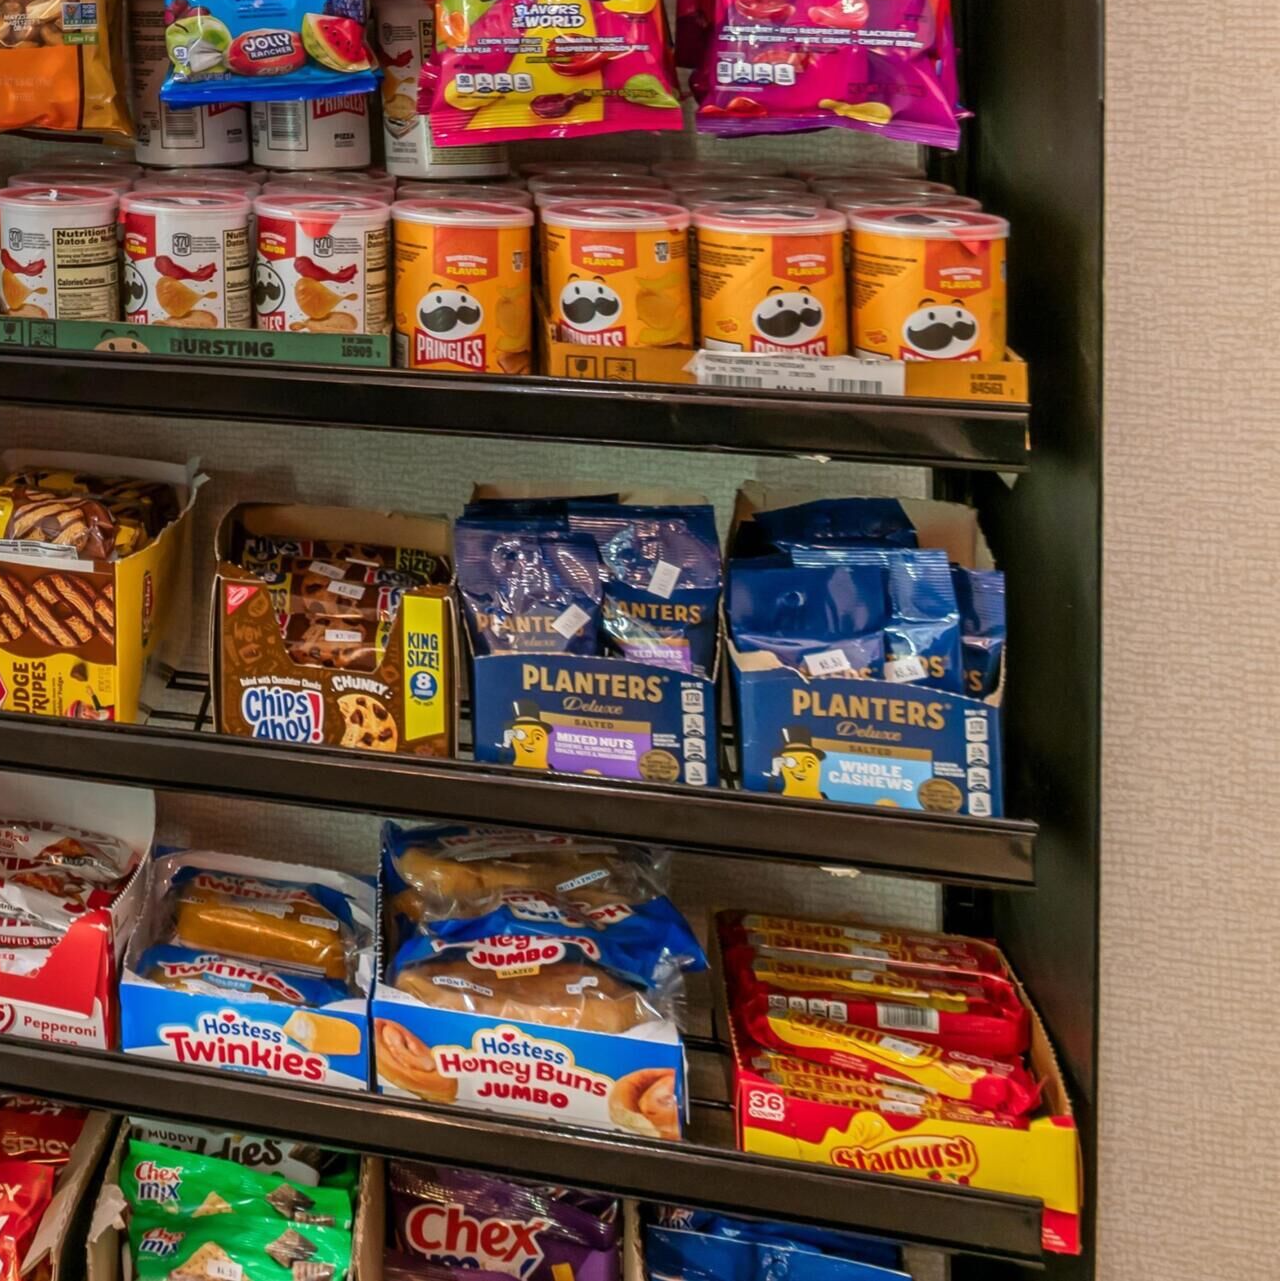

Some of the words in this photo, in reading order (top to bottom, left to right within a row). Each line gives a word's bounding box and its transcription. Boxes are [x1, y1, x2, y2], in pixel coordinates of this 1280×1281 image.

[515, 5, 578, 15] FLAVORS
[525, 13, 584, 28] WORLD
[242, 34, 290, 52] JOLLY
[250, 46, 294, 60] RANCHER
[57, 230, 105, 241] Nutrition
[170, 339, 274, 358] BURSTING
[416, 336, 482, 365] PRINGLES
[407, 632, 438, 650] KING
[407, 650, 439, 669] SIZE!
[523, 664, 662, 702] PLANTERS
[563, 696, 623, 716] Deluxe
[793, 689, 945, 728] PLANTERS
[574, 718, 613, 731] SALTED
[837, 721, 902, 742] Deluxe
[557, 732, 595, 746] MIXED
[598, 737, 633, 750] NUTS
[849, 745, 891, 757] SALTED
[839, 761, 902, 778] WHOLE
[829, 771, 913, 792] CASHEWS
[24, 1016, 97, 1037] Pepperoni
[204, 1019, 282, 1042] Hostess
[165, 1031, 326, 1081] Twinkies
[482, 1037, 565, 1063] Hostess
[477, 1081, 568, 1109] JUMBO
[752, 1093, 781, 1111] 36
[148, 1130, 194, 1143] MUDDY
[135, 1161, 182, 1183] Chex
[411, 1205, 542, 1256] Chex
